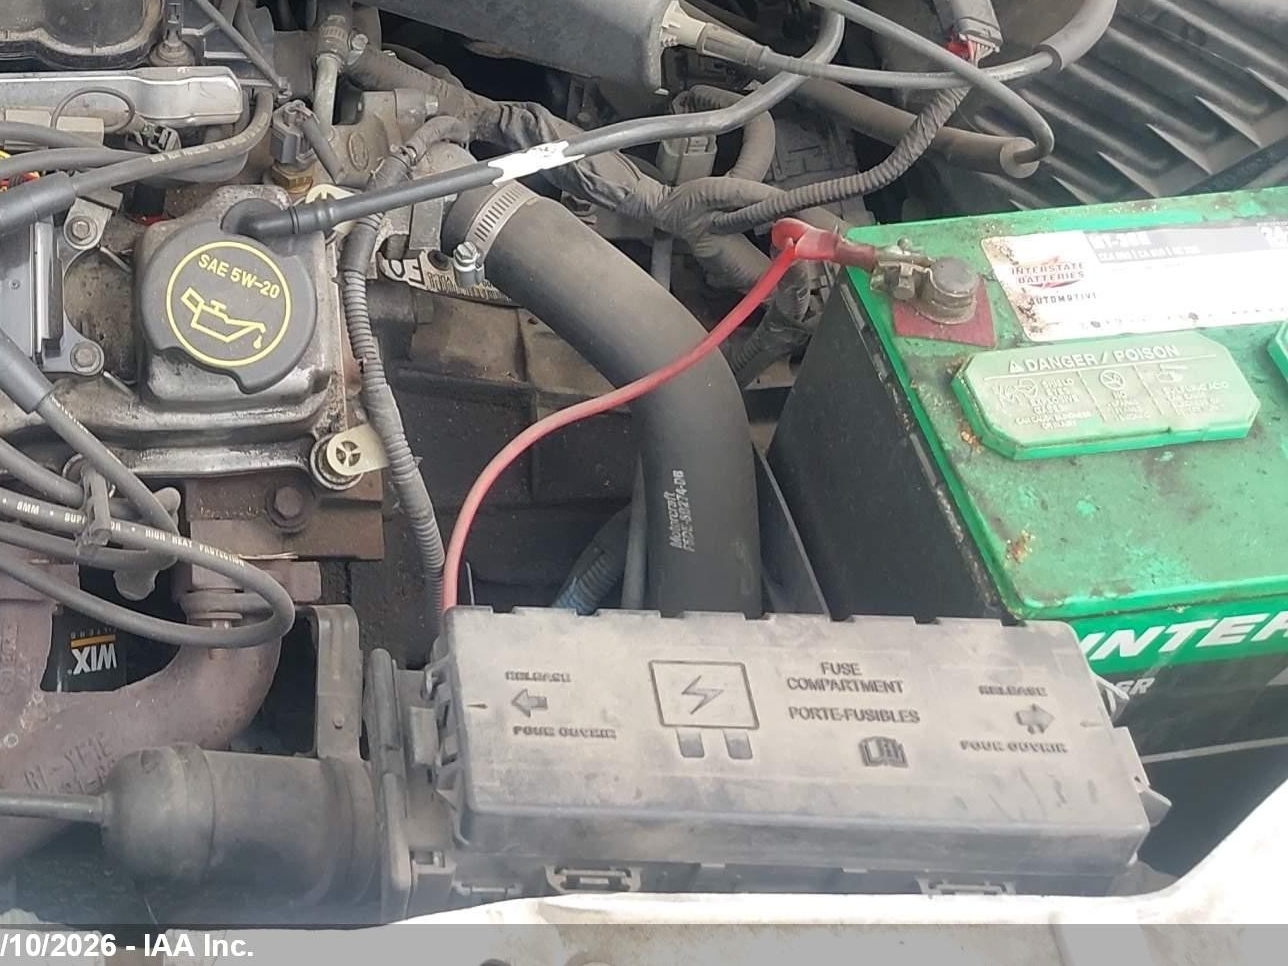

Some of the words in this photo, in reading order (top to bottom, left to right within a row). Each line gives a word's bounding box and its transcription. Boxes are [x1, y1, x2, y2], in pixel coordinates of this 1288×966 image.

[198, 253, 230, 278] SAE
[230, 267, 281, 299] 5W-20
[1012, 262, 1085, 275] INTERSTATE
[1018, 271, 1085, 284] BATTERIES
[1024, 352, 1098, 372] DANGER
[1113, 345, 1180, 364] POISON
[71, 643, 118, 676] WIX
[819, 661, 863, 676] FUSE
[786, 677, 904, 694] COMPARTMENT
[788, 706, 921, 725] PORTE-FUSIBLES
[512, 725, 555, 738] POUR
[960, 739, 1004, 752] POUR
